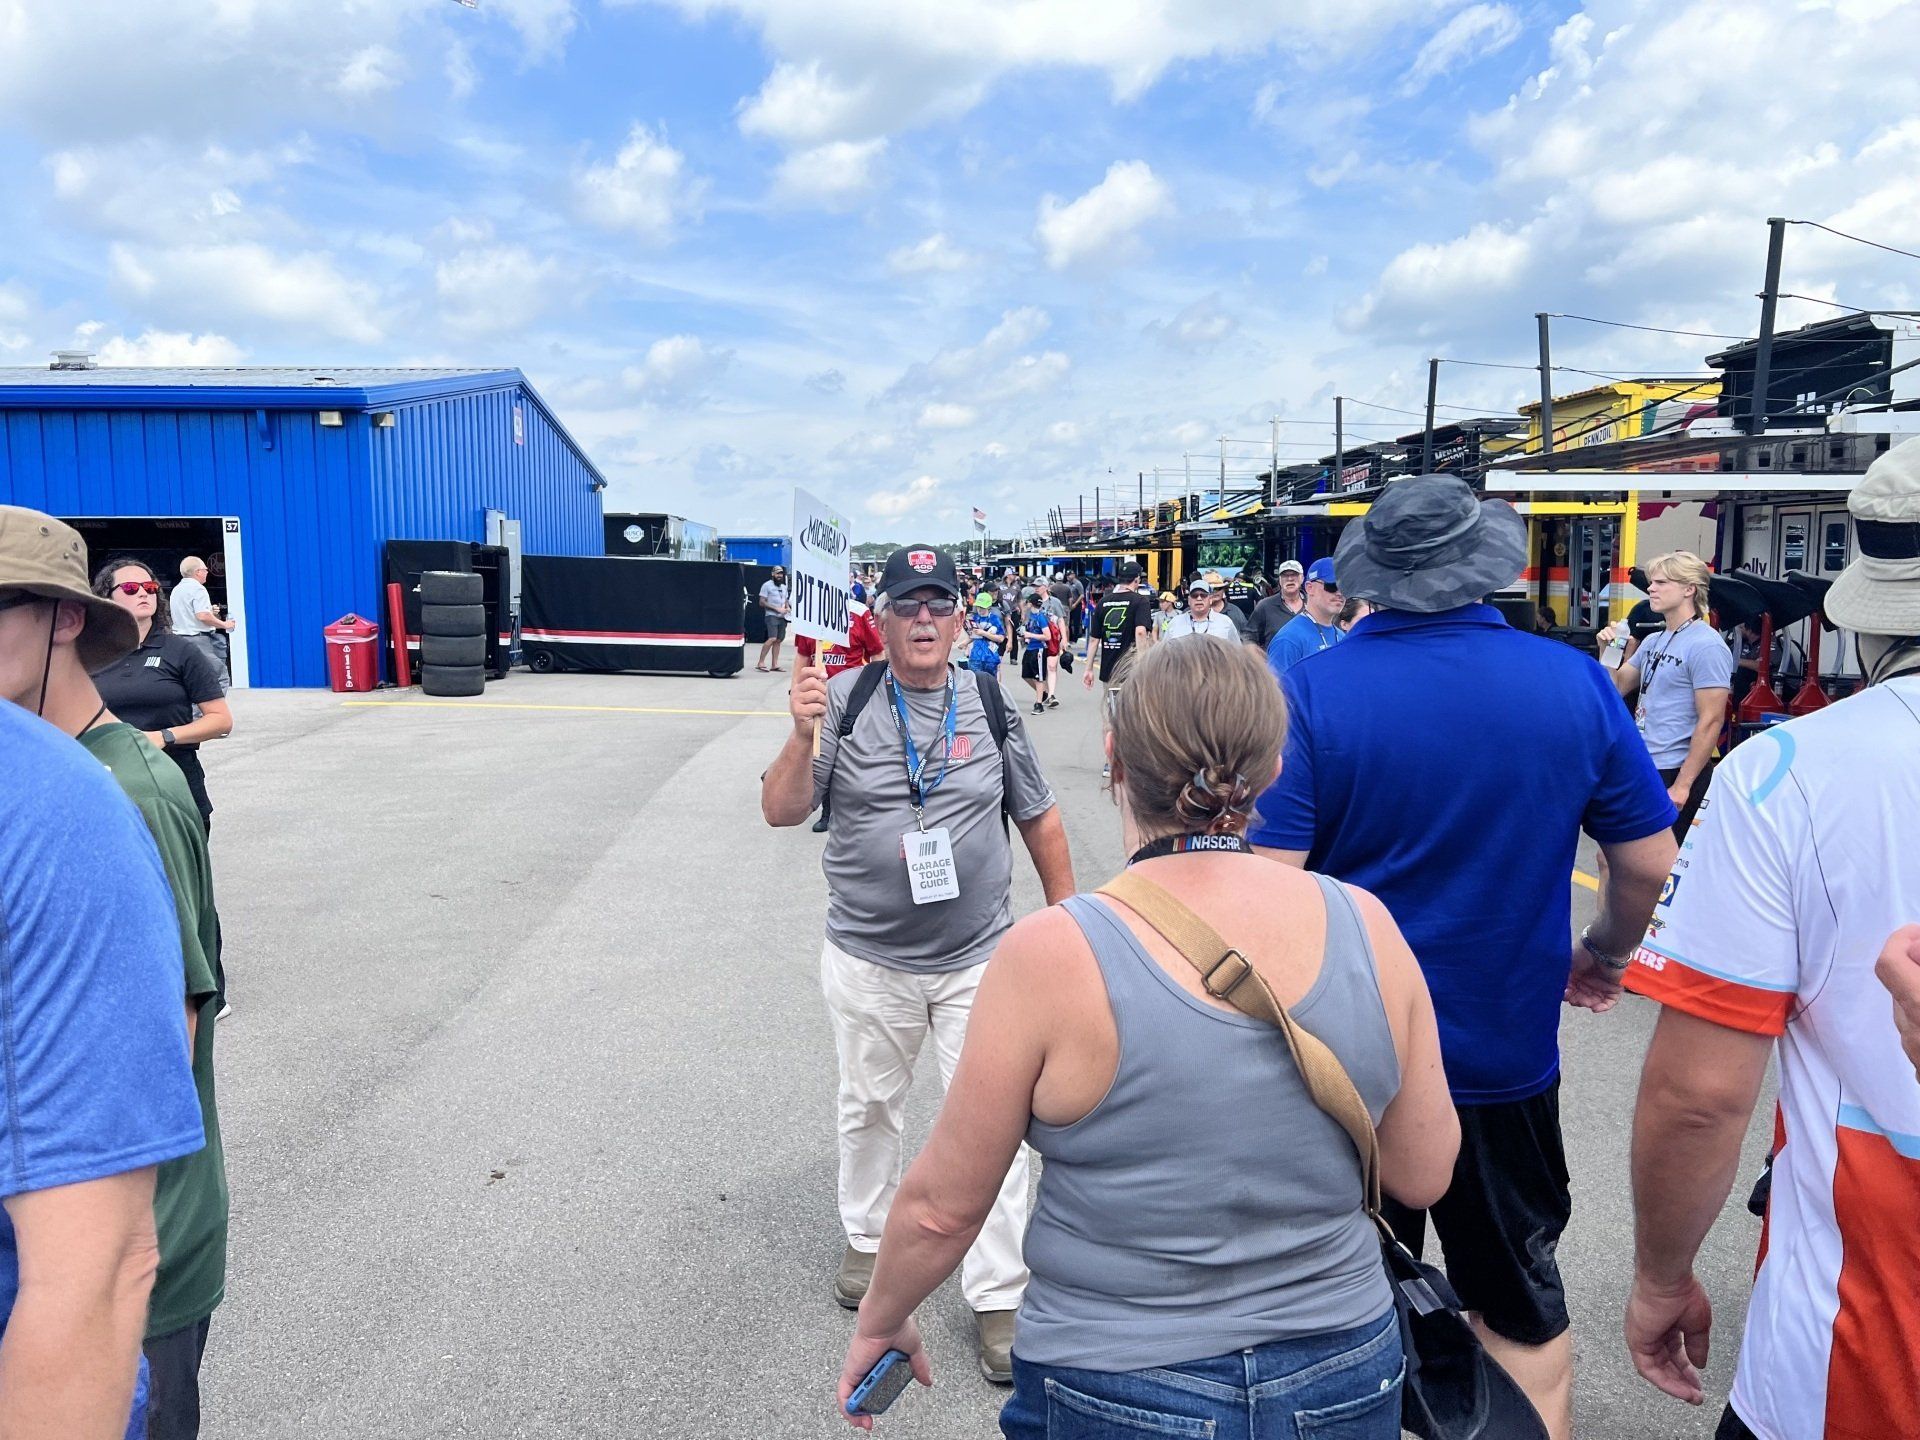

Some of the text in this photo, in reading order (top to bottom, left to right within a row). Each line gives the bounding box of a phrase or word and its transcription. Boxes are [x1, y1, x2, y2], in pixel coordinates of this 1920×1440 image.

[1583, 426, 1612, 446] PENNZOIL
[226, 522, 238, 531] 37
[807, 515, 841, 557] MICHIGAN
[796, 570, 849, 634] PIT TOURS
[1002, 592, 1015, 602] ally
[811, 653, 846, 666] NZOIL
[913, 758, 927, 783] NASCAR
[1191, 835, 1240, 850] NASCAR
[911, 858, 951, 872] GARAGE
[919, 868, 946, 880] TOUR
[920, 877, 949, 889] GUIDE
[1633, 947, 1667, 972] TERS
